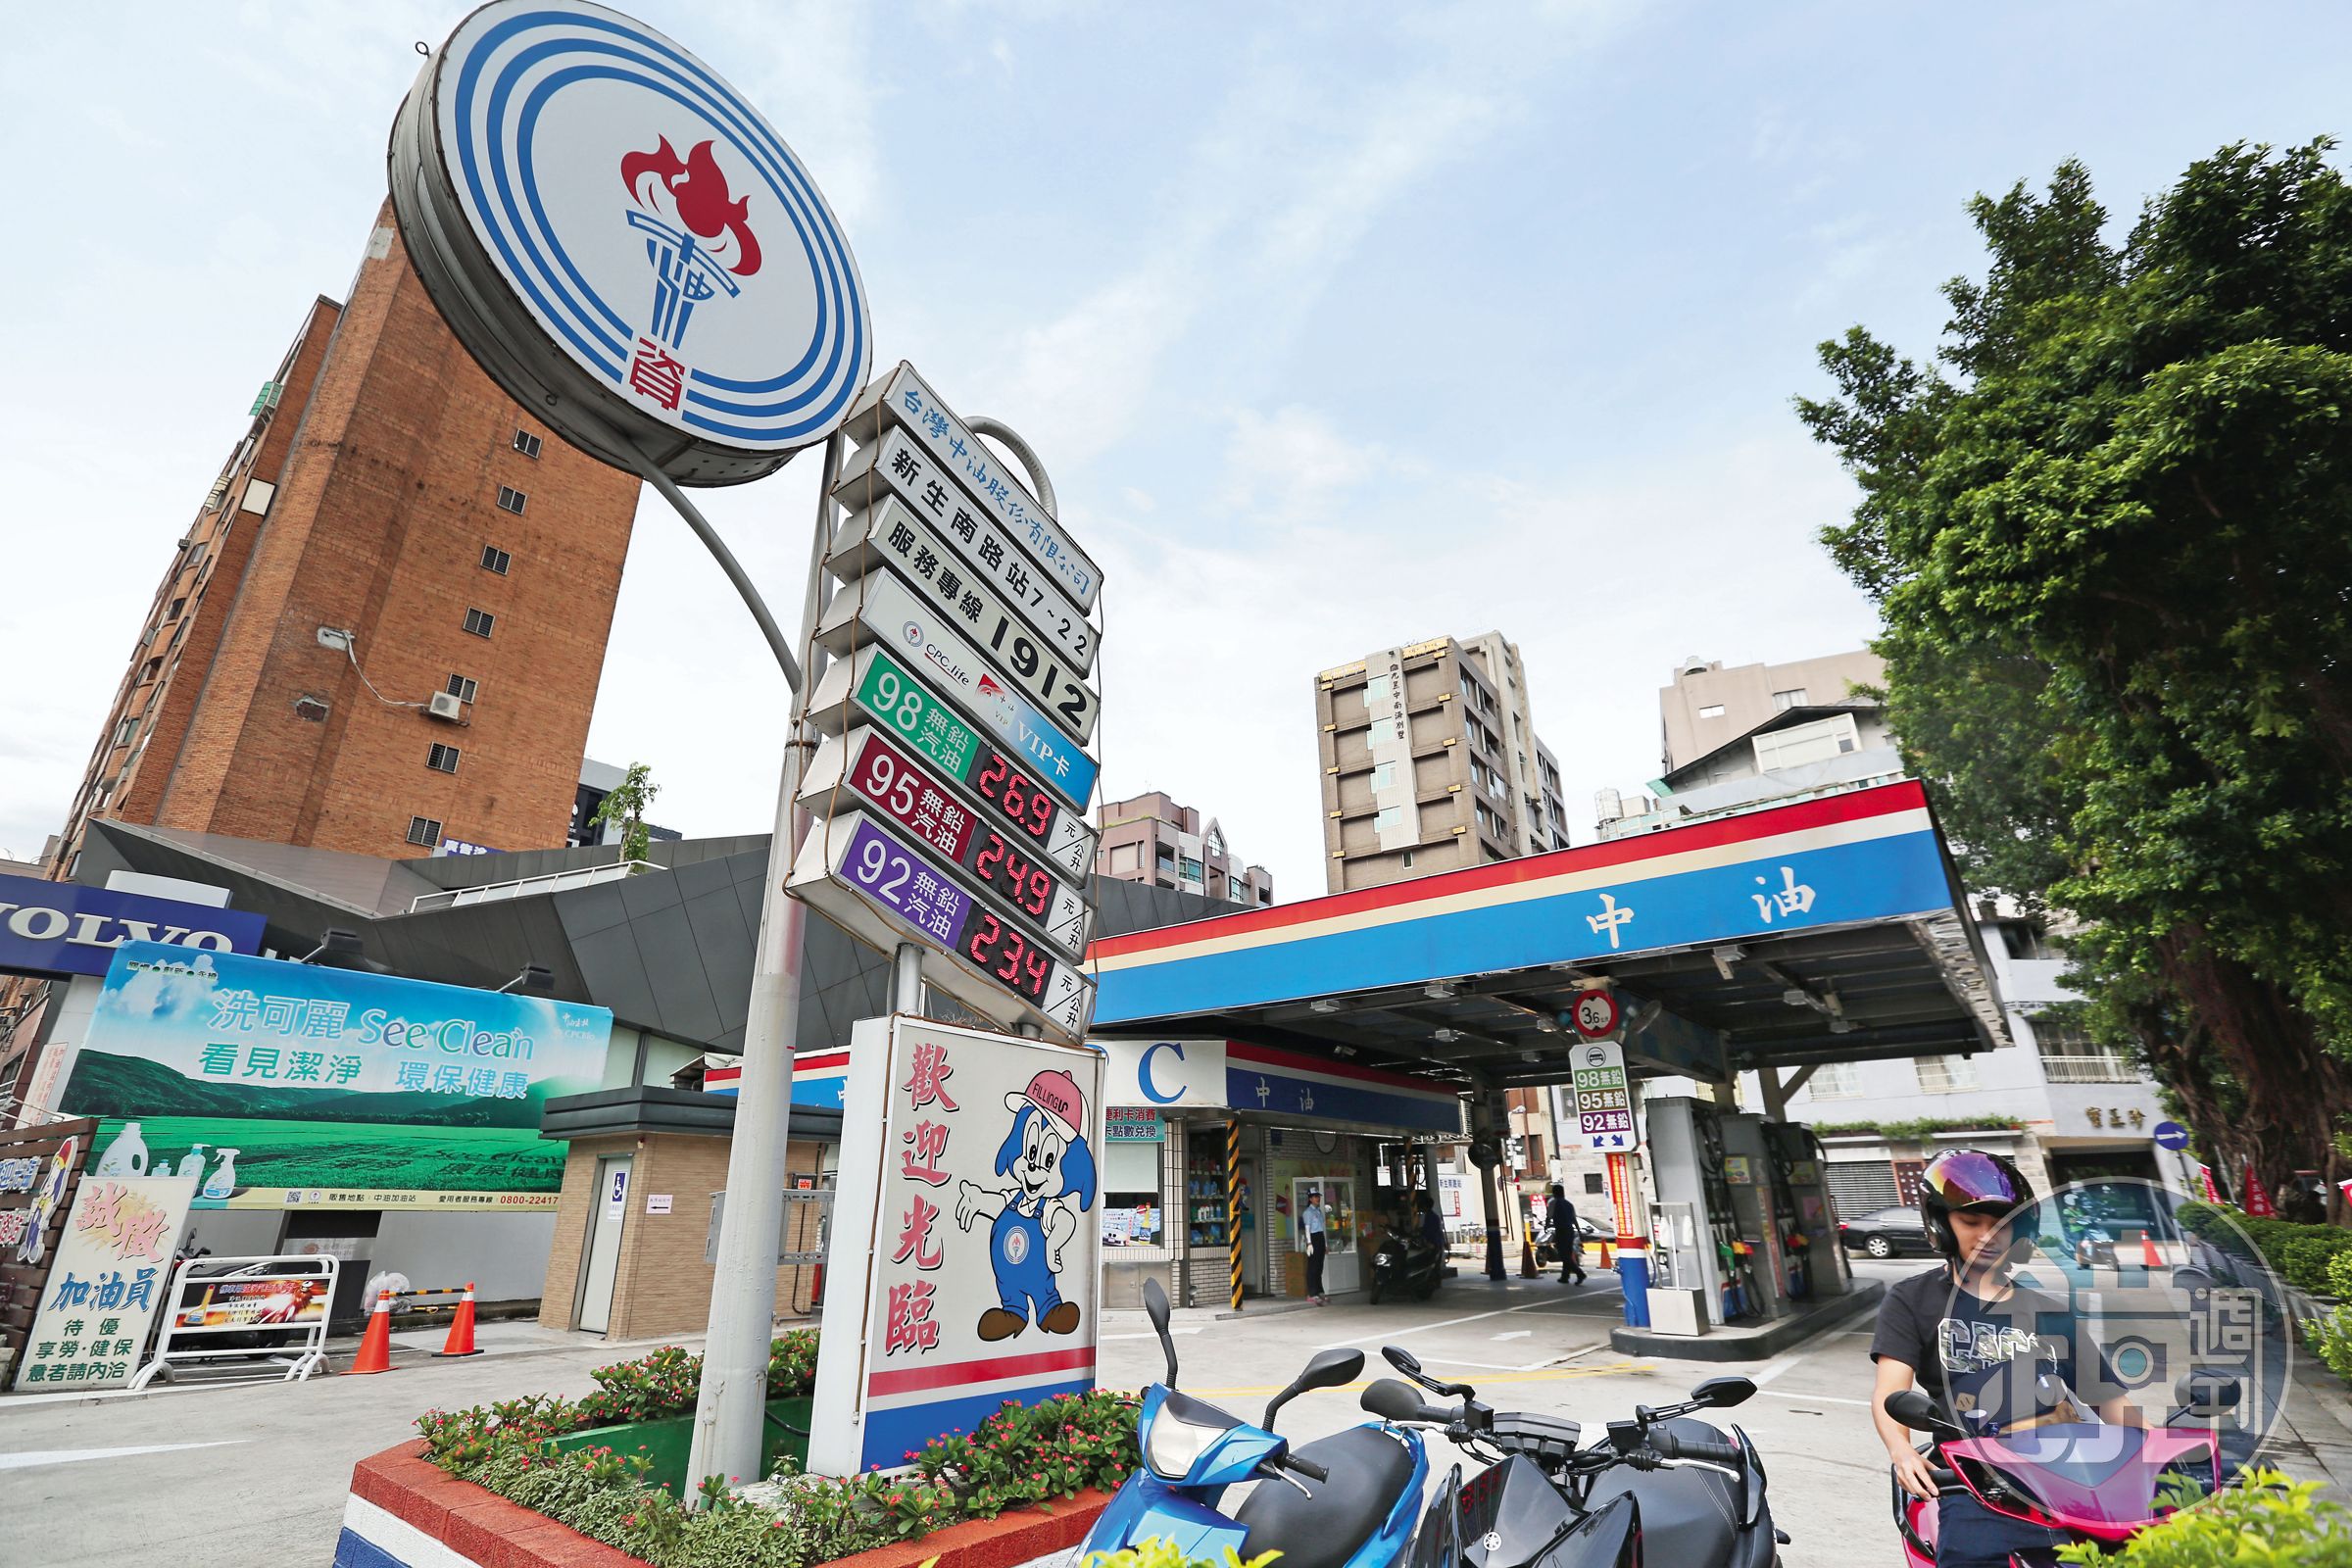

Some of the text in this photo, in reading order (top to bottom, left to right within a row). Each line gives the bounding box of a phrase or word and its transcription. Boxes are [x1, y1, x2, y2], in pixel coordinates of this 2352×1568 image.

[629, 337, 685, 411] 資
[904, 391, 1090, 595] 台灣中油股份有限公司
[888, 521, 1087, 728] 服務專線 1912
[872, 672, 923, 730] 98
[916, 728, 960, 774] 汽油
[925, 708, 969, 754] 無鉛
[865, 755, 918, 815] 95
[920, 789, 965, 834] 無鉛
[979, 754, 1051, 836] 26.9
[911, 808, 956, 856] 汽油
[858, 839, 911, 905] 92
[913, 871, 960, 916] 無鉛
[976, 834, 1050, 915] 24.9
[904, 893, 952, 940] 汽油
[1586, 867, 1816, 949] 中油
[970, 914, 1047, 997] 23.4
[208, 989, 535, 1060] 洗可麗 See Clean
[198, 1042, 528, 1100] 看見潔淨 環保健康
[1255, 1077, 1314, 1112] 中油
[1577, 1069, 1623, 1088] 98 無鉛
[1580, 1092, 1626, 1109] 95 無鉛
[1583, 1112, 1629, 1131] 92 無鉛
[885, 1043, 959, 1356] 歡迎光臨
[47, 1267, 159, 1312] 加油員
